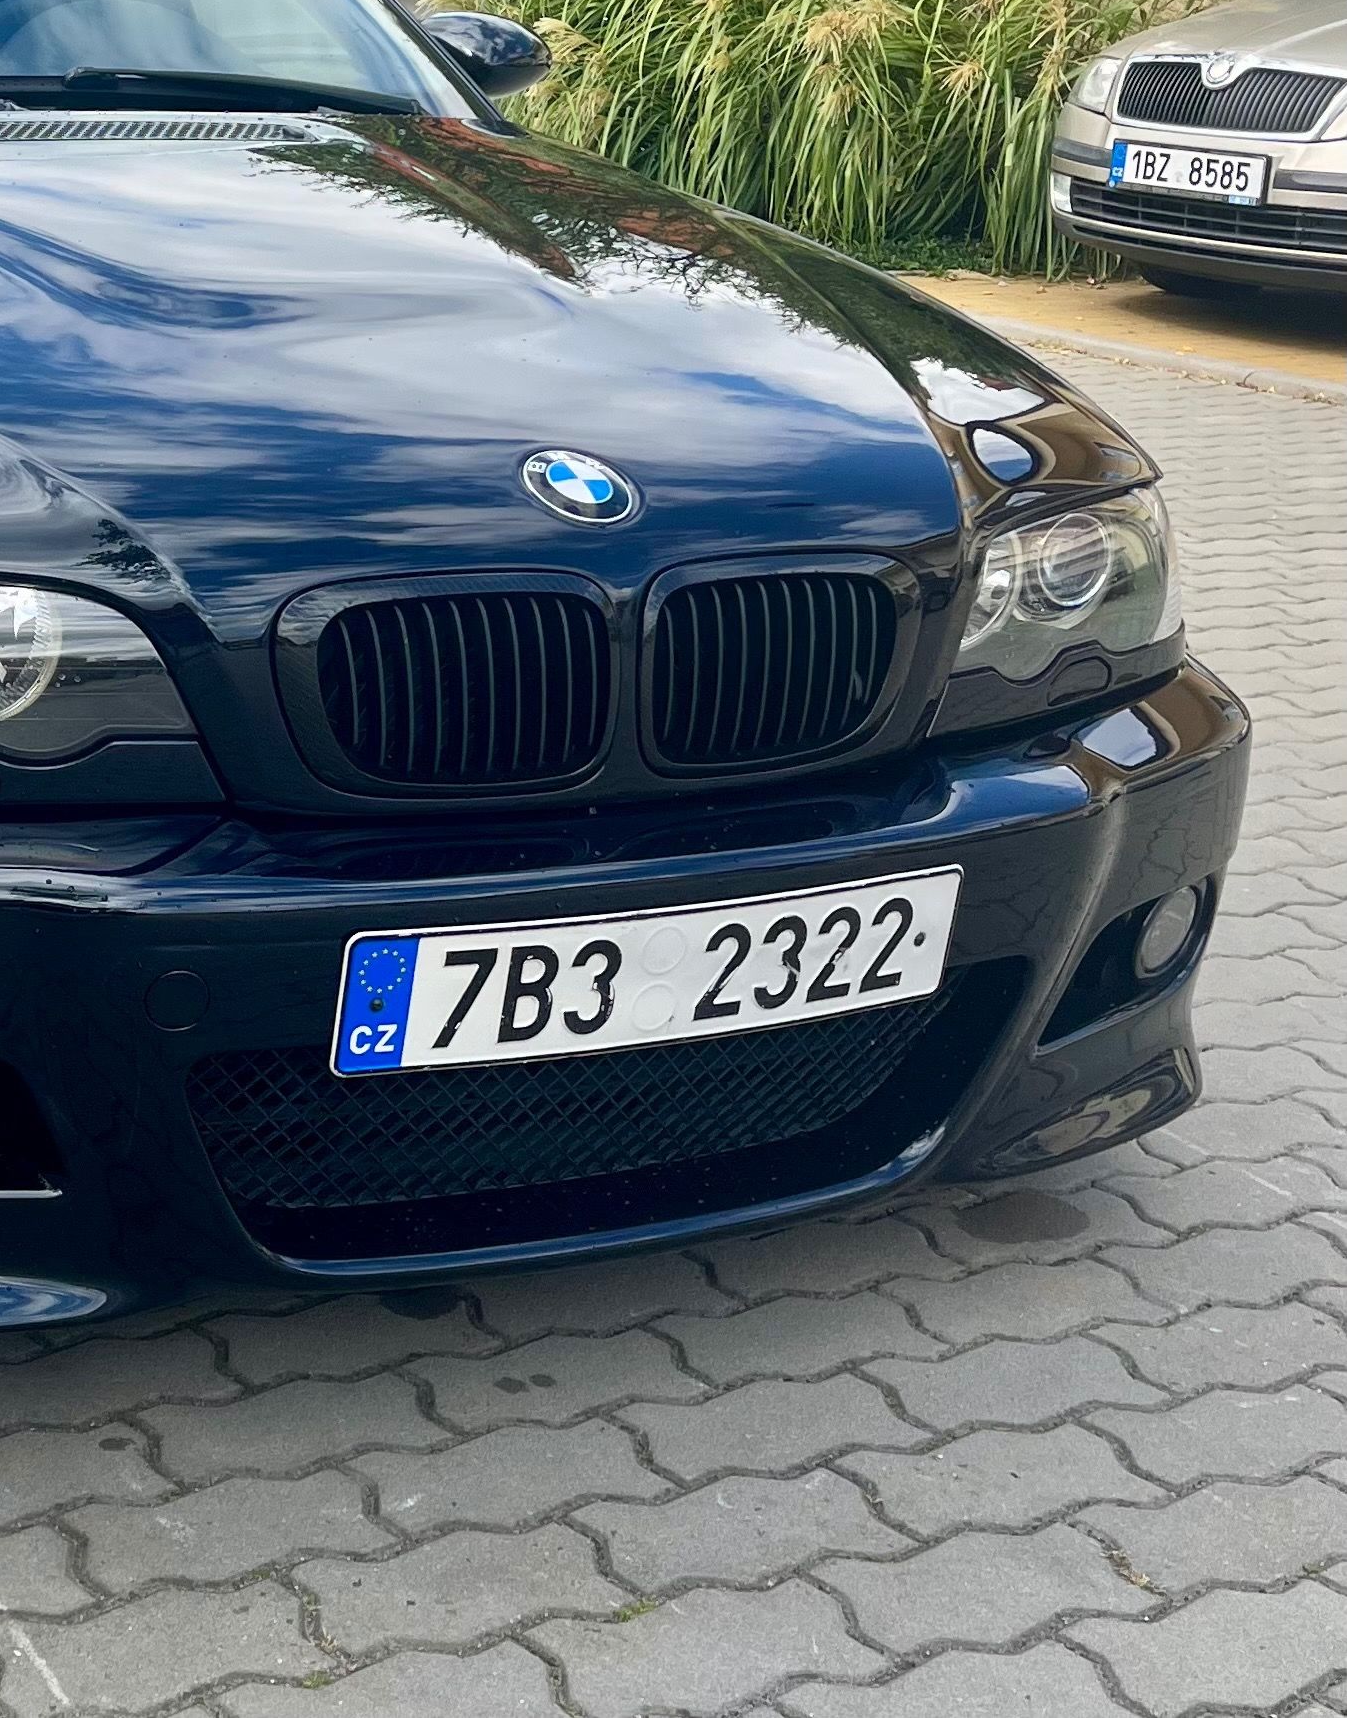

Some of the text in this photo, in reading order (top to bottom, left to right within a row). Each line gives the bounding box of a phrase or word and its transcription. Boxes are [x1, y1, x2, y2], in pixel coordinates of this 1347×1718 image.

[1132, 150, 1171, 182] 1BZ
[1188, 157, 1251, 192] 8585
[431, 897, 915, 1049] 7B3 2322
[348, 1024, 396, 1055] CZ
